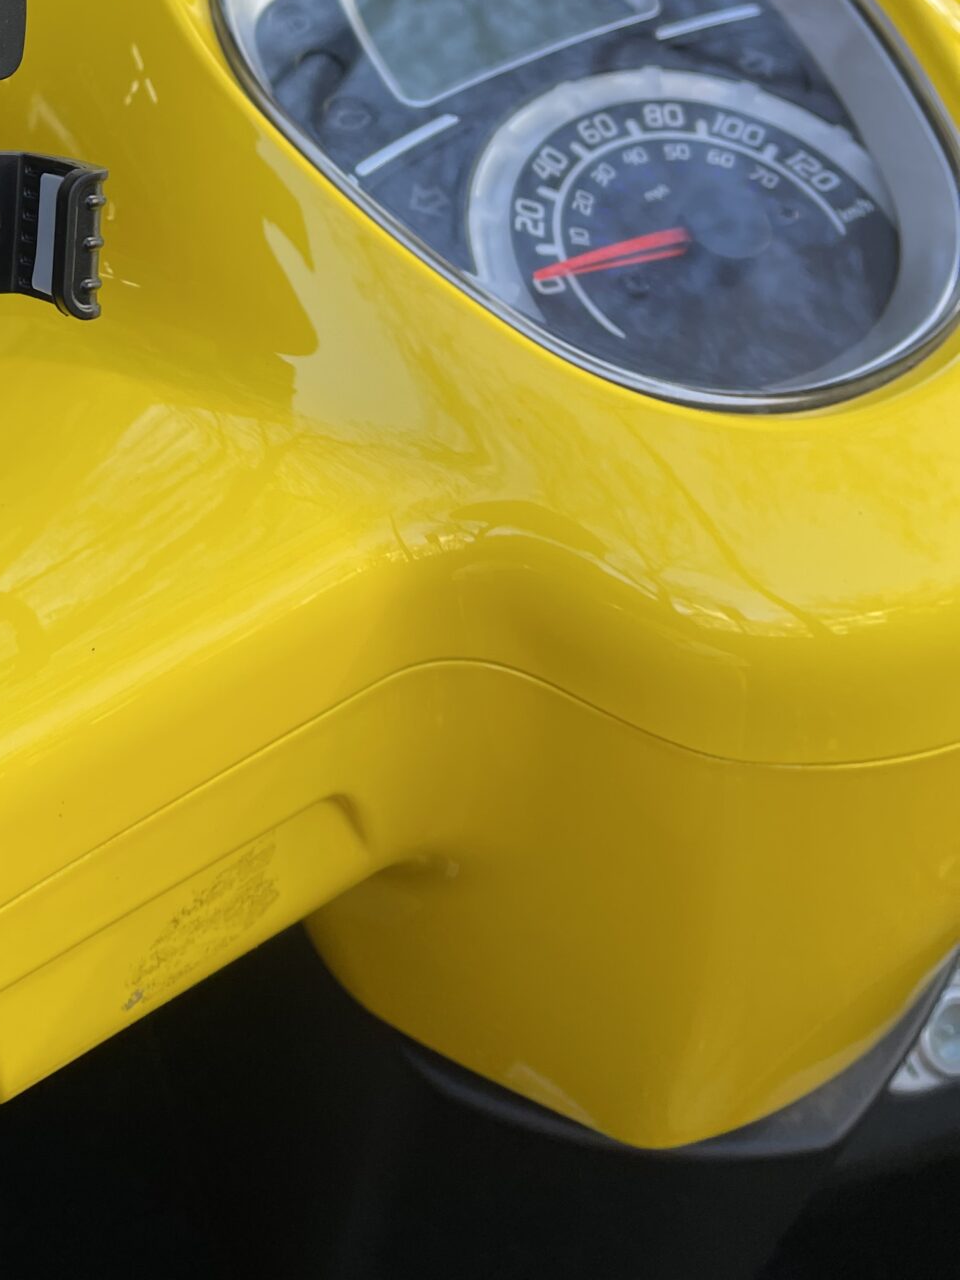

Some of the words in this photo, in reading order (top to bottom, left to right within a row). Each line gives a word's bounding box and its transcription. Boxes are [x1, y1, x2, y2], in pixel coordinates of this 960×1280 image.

[577, 112, 618, 144] 60
[643, 104, 684, 128] 80
[712, 111, 766, 148] 100
[532, 146, 569, 180] 40
[622, 146, 649, 166] 40
[663, 143, 691, 161] 50
[706, 149, 736, 169] 60
[590, 161, 617, 187] 30
[749, 164, 780, 190] 70
[785, 149, 840, 192] 120
[572, 189, 594, 217] 20
[514, 197, 545, 238] 20
[568, 226, 590, 247] 10
